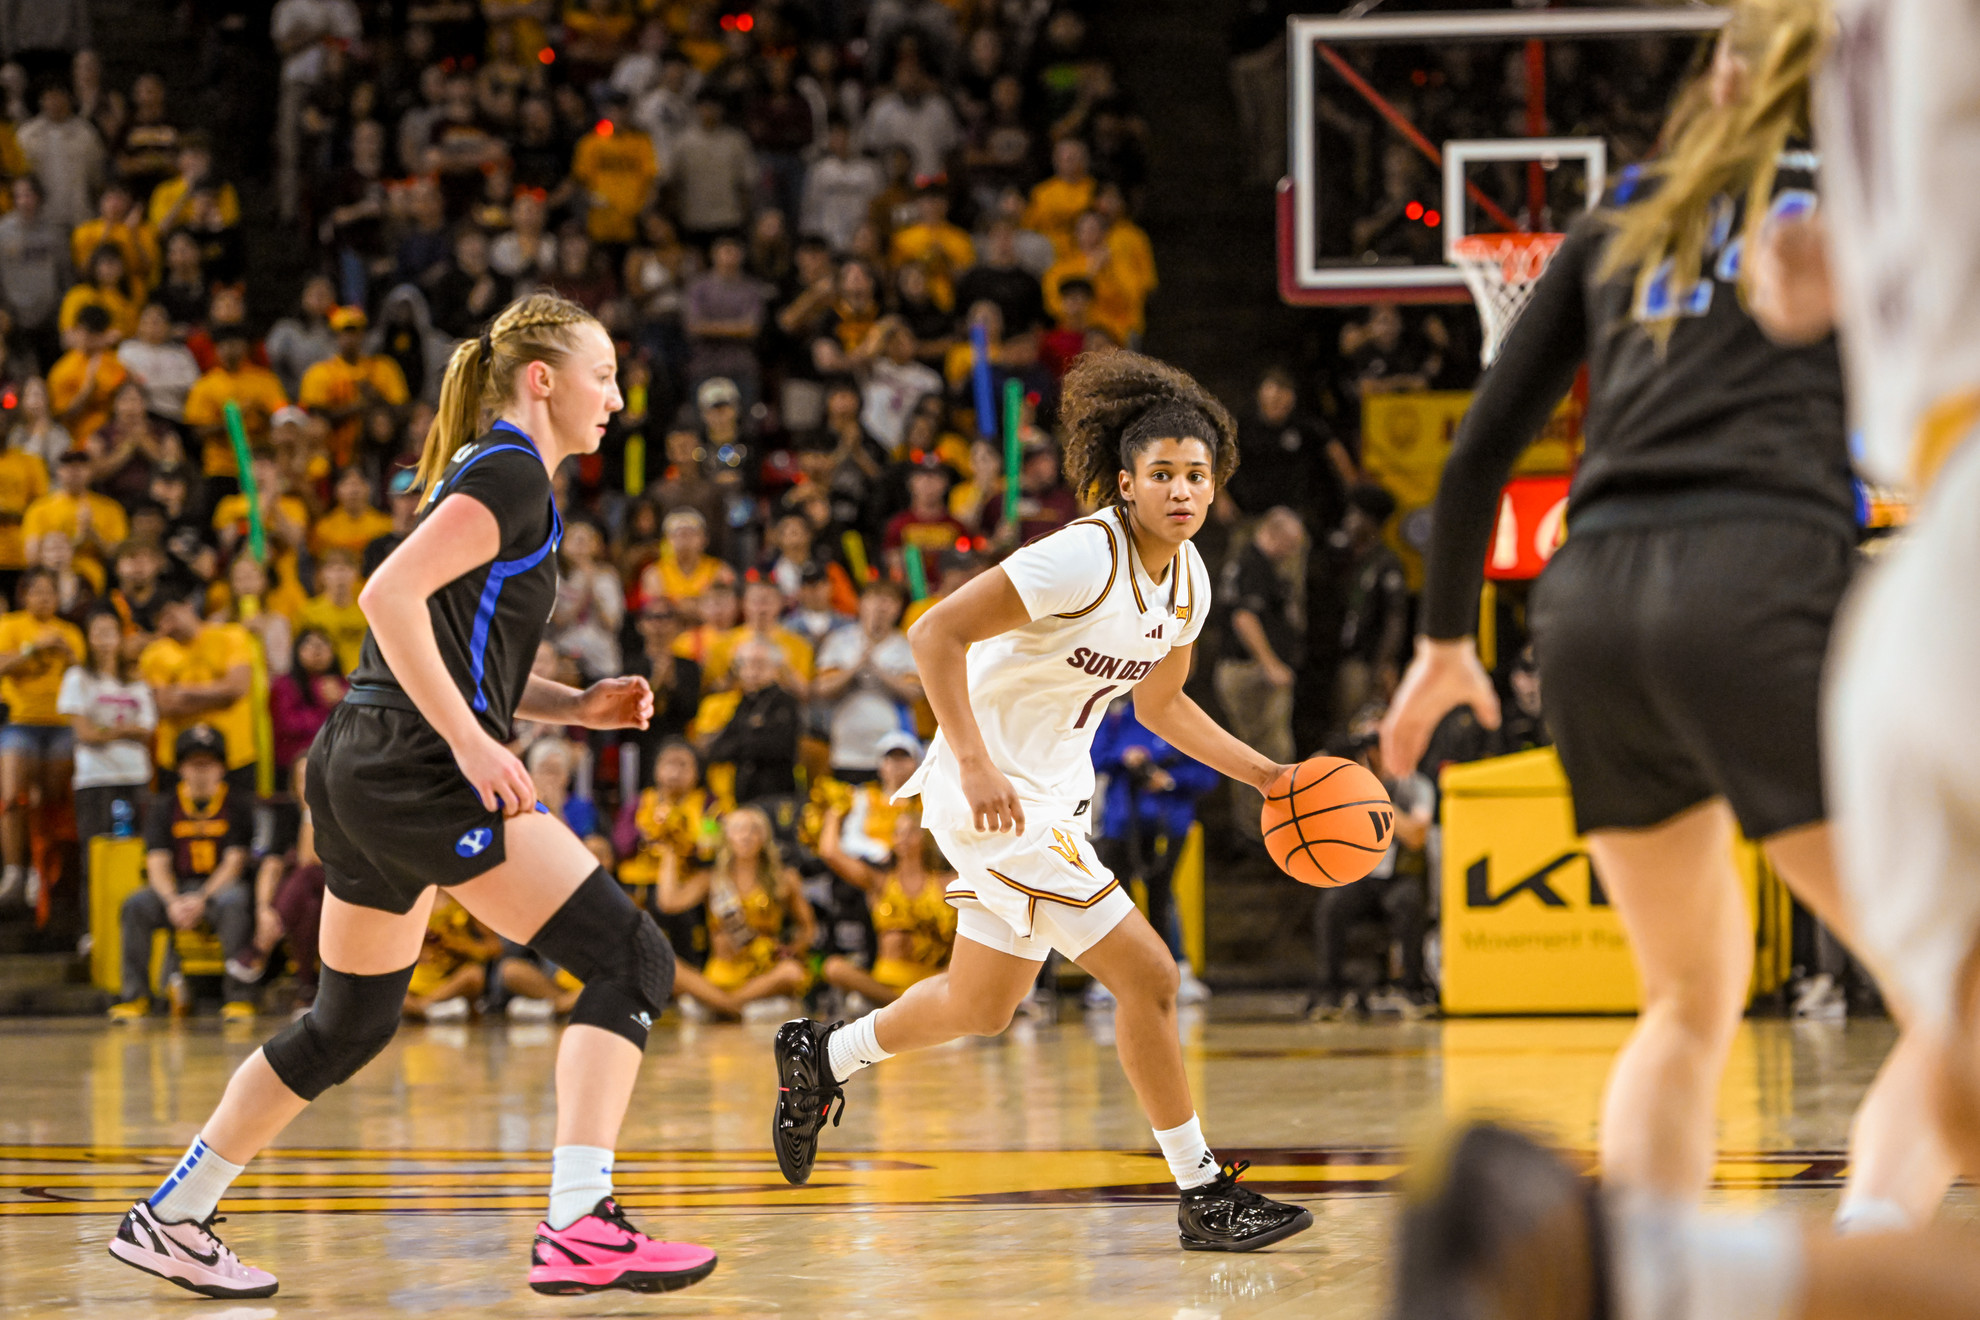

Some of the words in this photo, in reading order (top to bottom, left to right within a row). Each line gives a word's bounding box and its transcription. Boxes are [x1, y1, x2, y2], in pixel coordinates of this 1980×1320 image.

[1066, 647, 1122, 680] SUN
[1115, 656, 1163, 680] DEV
[1073, 685, 1118, 729] 1
[459, 830, 484, 854] Y
[1466, 852, 1609, 908] KI
